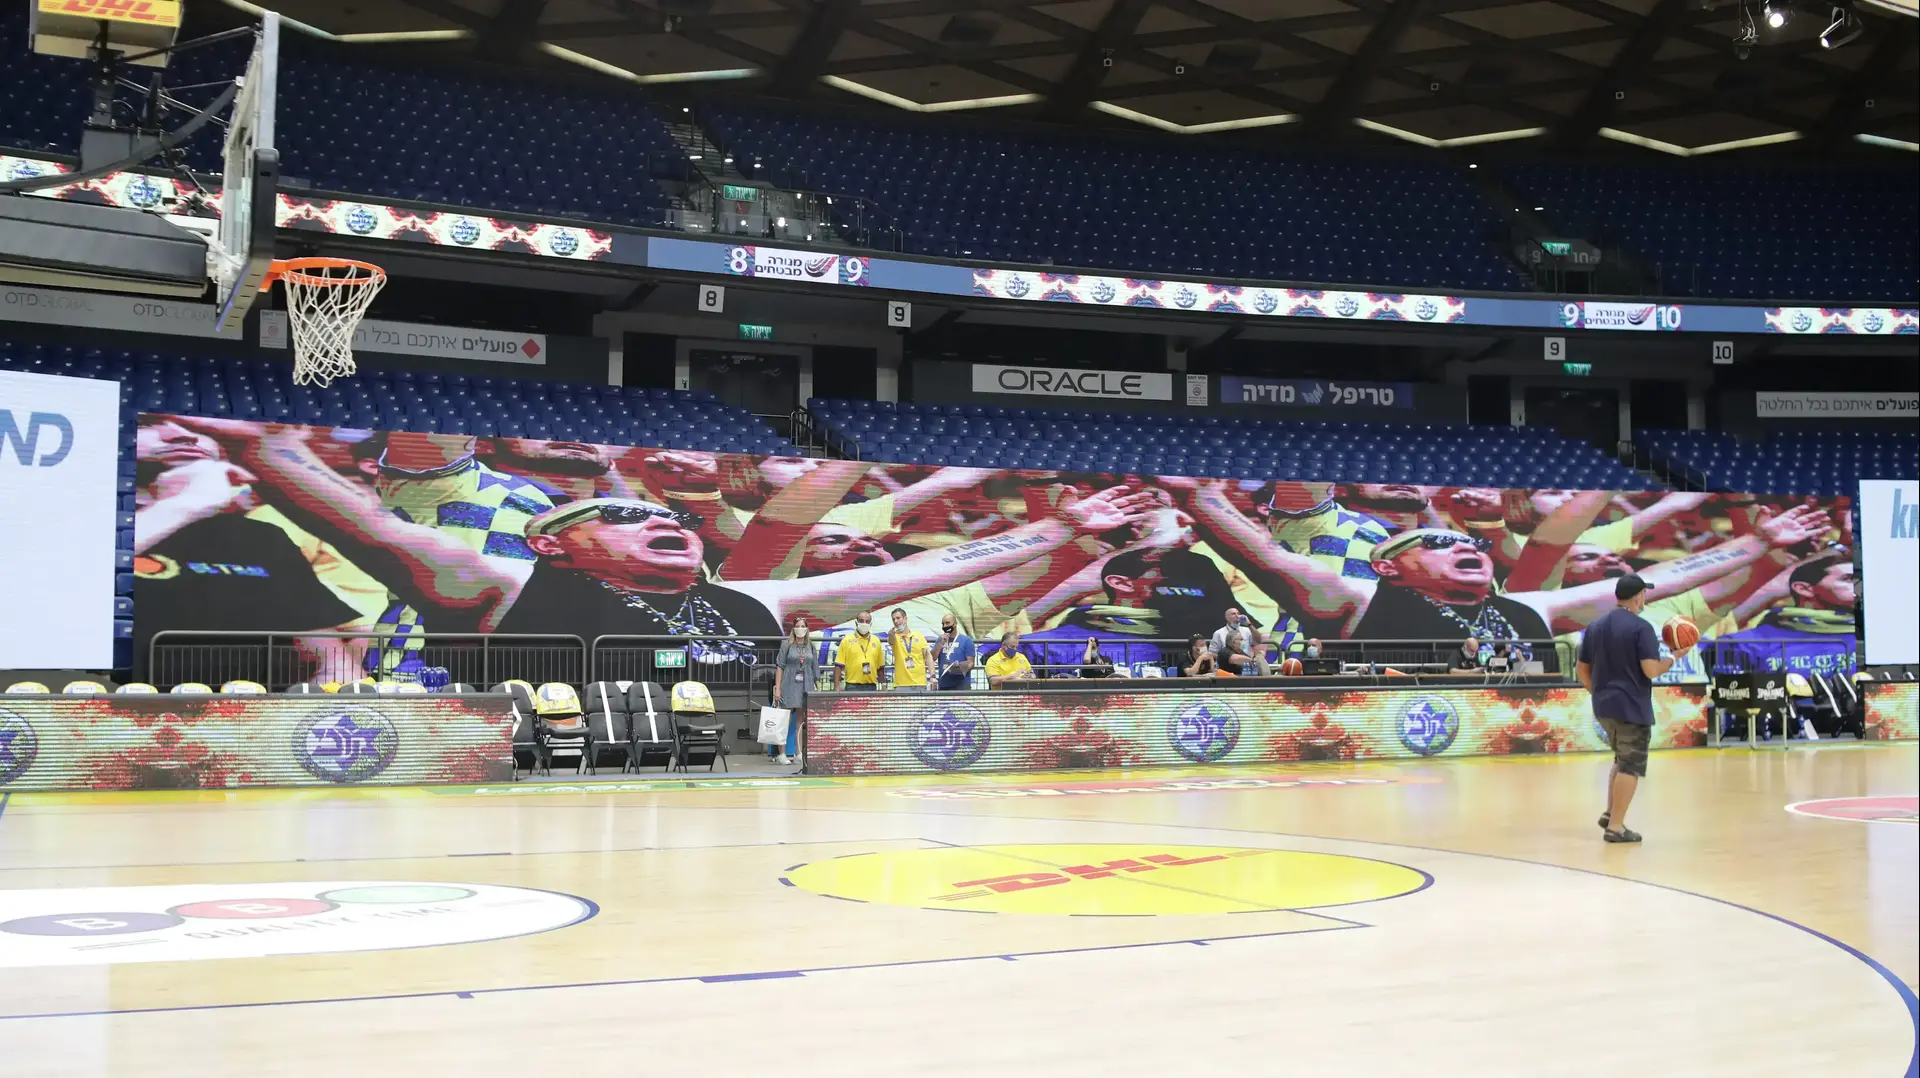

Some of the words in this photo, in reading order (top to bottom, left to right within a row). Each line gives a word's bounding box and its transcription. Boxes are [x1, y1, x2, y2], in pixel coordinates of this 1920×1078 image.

[730, 248, 748, 272] 8
[768, 256, 802, 267] מנורה
[755, 264, 802, 276] מבטחים
[846, 257, 862, 281] 9
[705, 290, 717, 307] 8
[894, 306, 905, 322] 9
[1563, 303, 1579, 325] 9
[1585, 317, 1625, 326] מבטחים
[1658, 306, 1681, 328] 10
[372, 326, 401, 345] בכל
[407, 332, 458, 349] איתכם
[462, 336, 518, 354] פועלים
[1550, 342, 1560, 355] 9
[1715, 346, 1732, 360] 10
[998, 369, 1142, 395] ORACLE
[1243, 384, 1295, 402] מדיה
[1329, 383, 1394, 406] טריפל
[1759, 397, 1803, 411] החלטה
[1806, 397, 1829, 411] בכל
[1833, 398, 1873, 411] איתכם
[1718, 687, 1750, 699] SPALDING
[1757, 687, 1784, 699] SPALDING
[952, 854, 1230, 893] DHL
[52, 917, 129, 931] B
[184, 916, 359, 940] QUALITY
